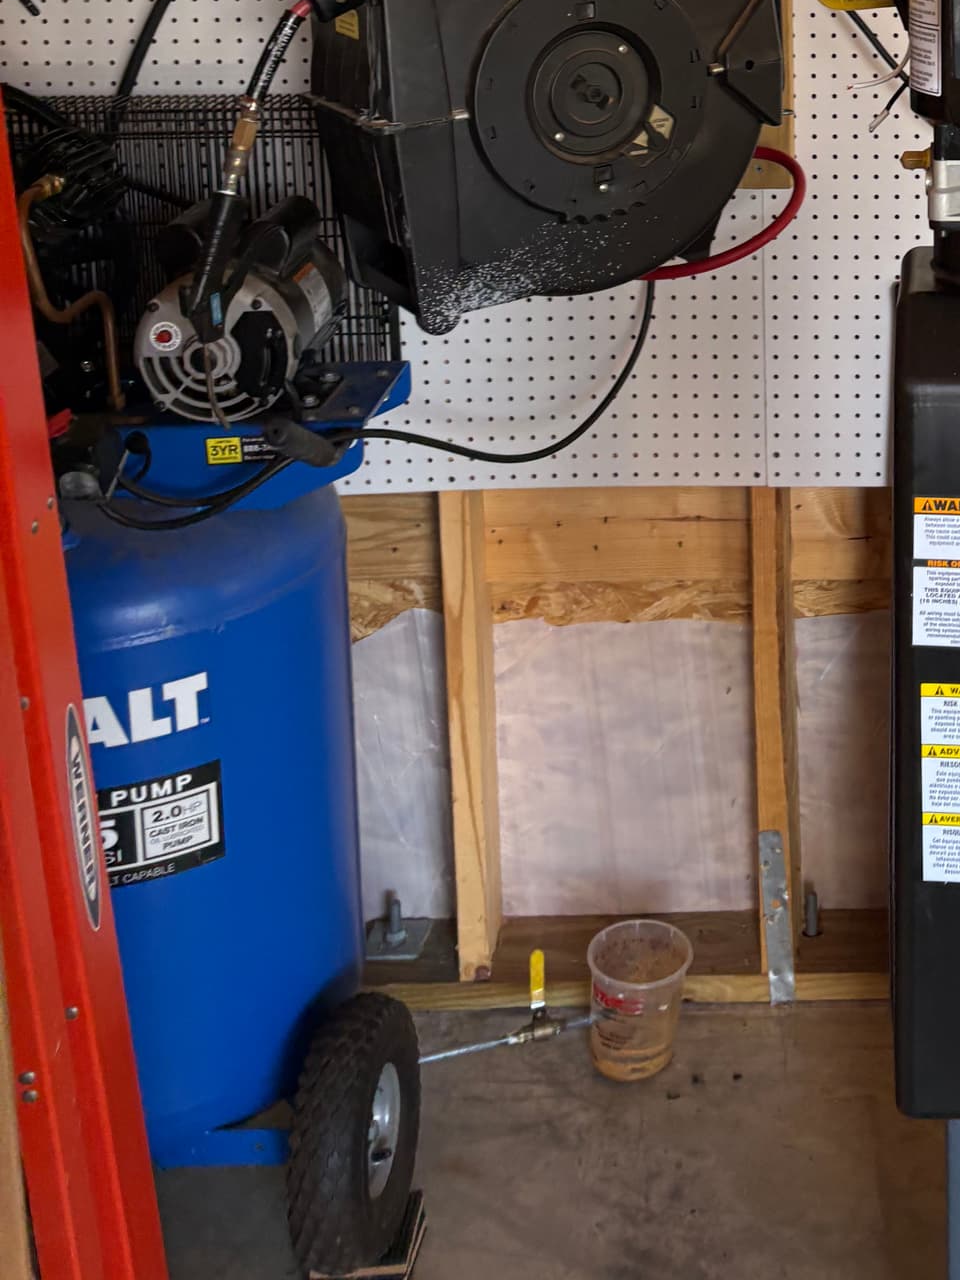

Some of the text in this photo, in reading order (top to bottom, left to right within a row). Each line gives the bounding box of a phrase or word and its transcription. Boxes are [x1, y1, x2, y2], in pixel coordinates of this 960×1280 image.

[210, 445, 239, 456] 3YR
[83, 672, 208, 748] ALT
[111, 774, 192, 807] PUMP
[72, 752, 95, 886] WERNER
[152, 800, 203, 823] 2.0 HP
[100, 819, 119, 850] 5
[149, 816, 203, 838] CAST IRON
[162, 835, 193, 850] PUMP
[105, 850, 122, 864] SI
[122, 863, 175, 883] CAPABLE
